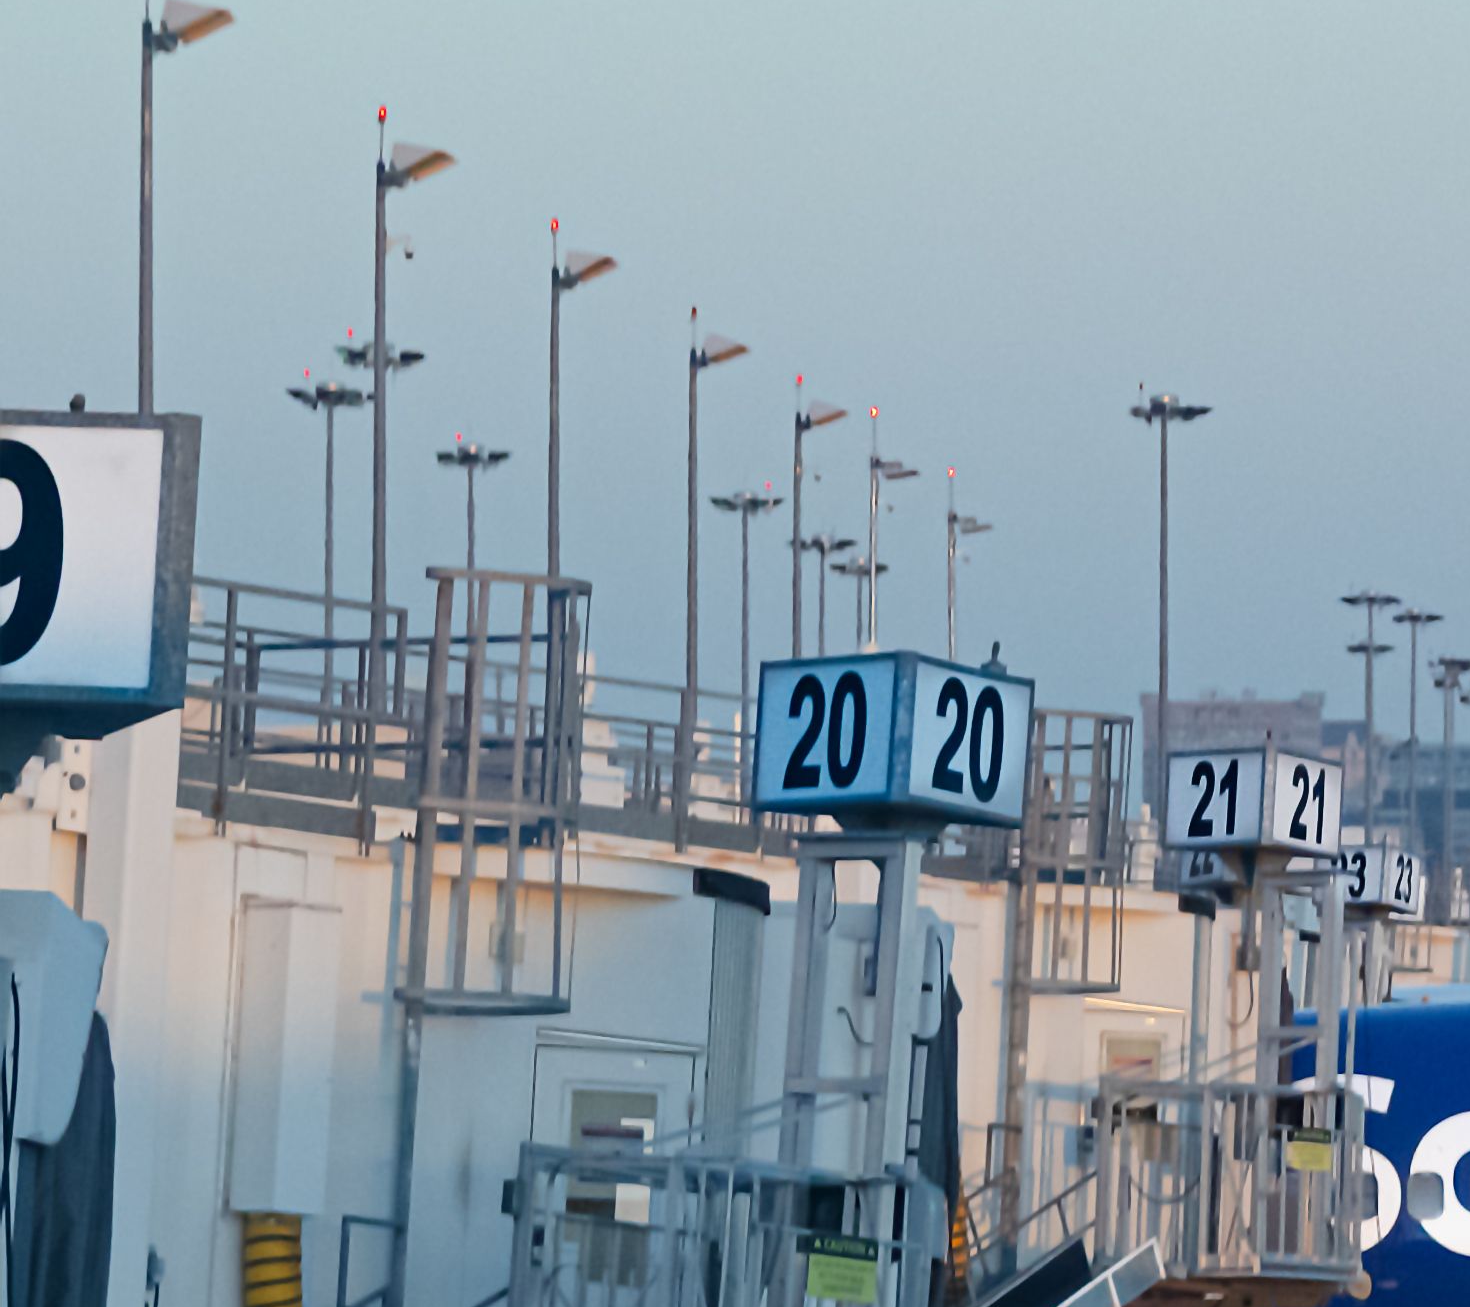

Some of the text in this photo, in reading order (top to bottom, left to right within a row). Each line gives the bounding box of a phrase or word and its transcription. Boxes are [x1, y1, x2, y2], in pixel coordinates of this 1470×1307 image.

[782, 670, 867, 789] 20
[932, 677, 1004, 803] 20
[1187, 758, 1238, 837] 21
[1289, 763, 1326, 844] 21
[1395, 853, 1413, 904] 23
